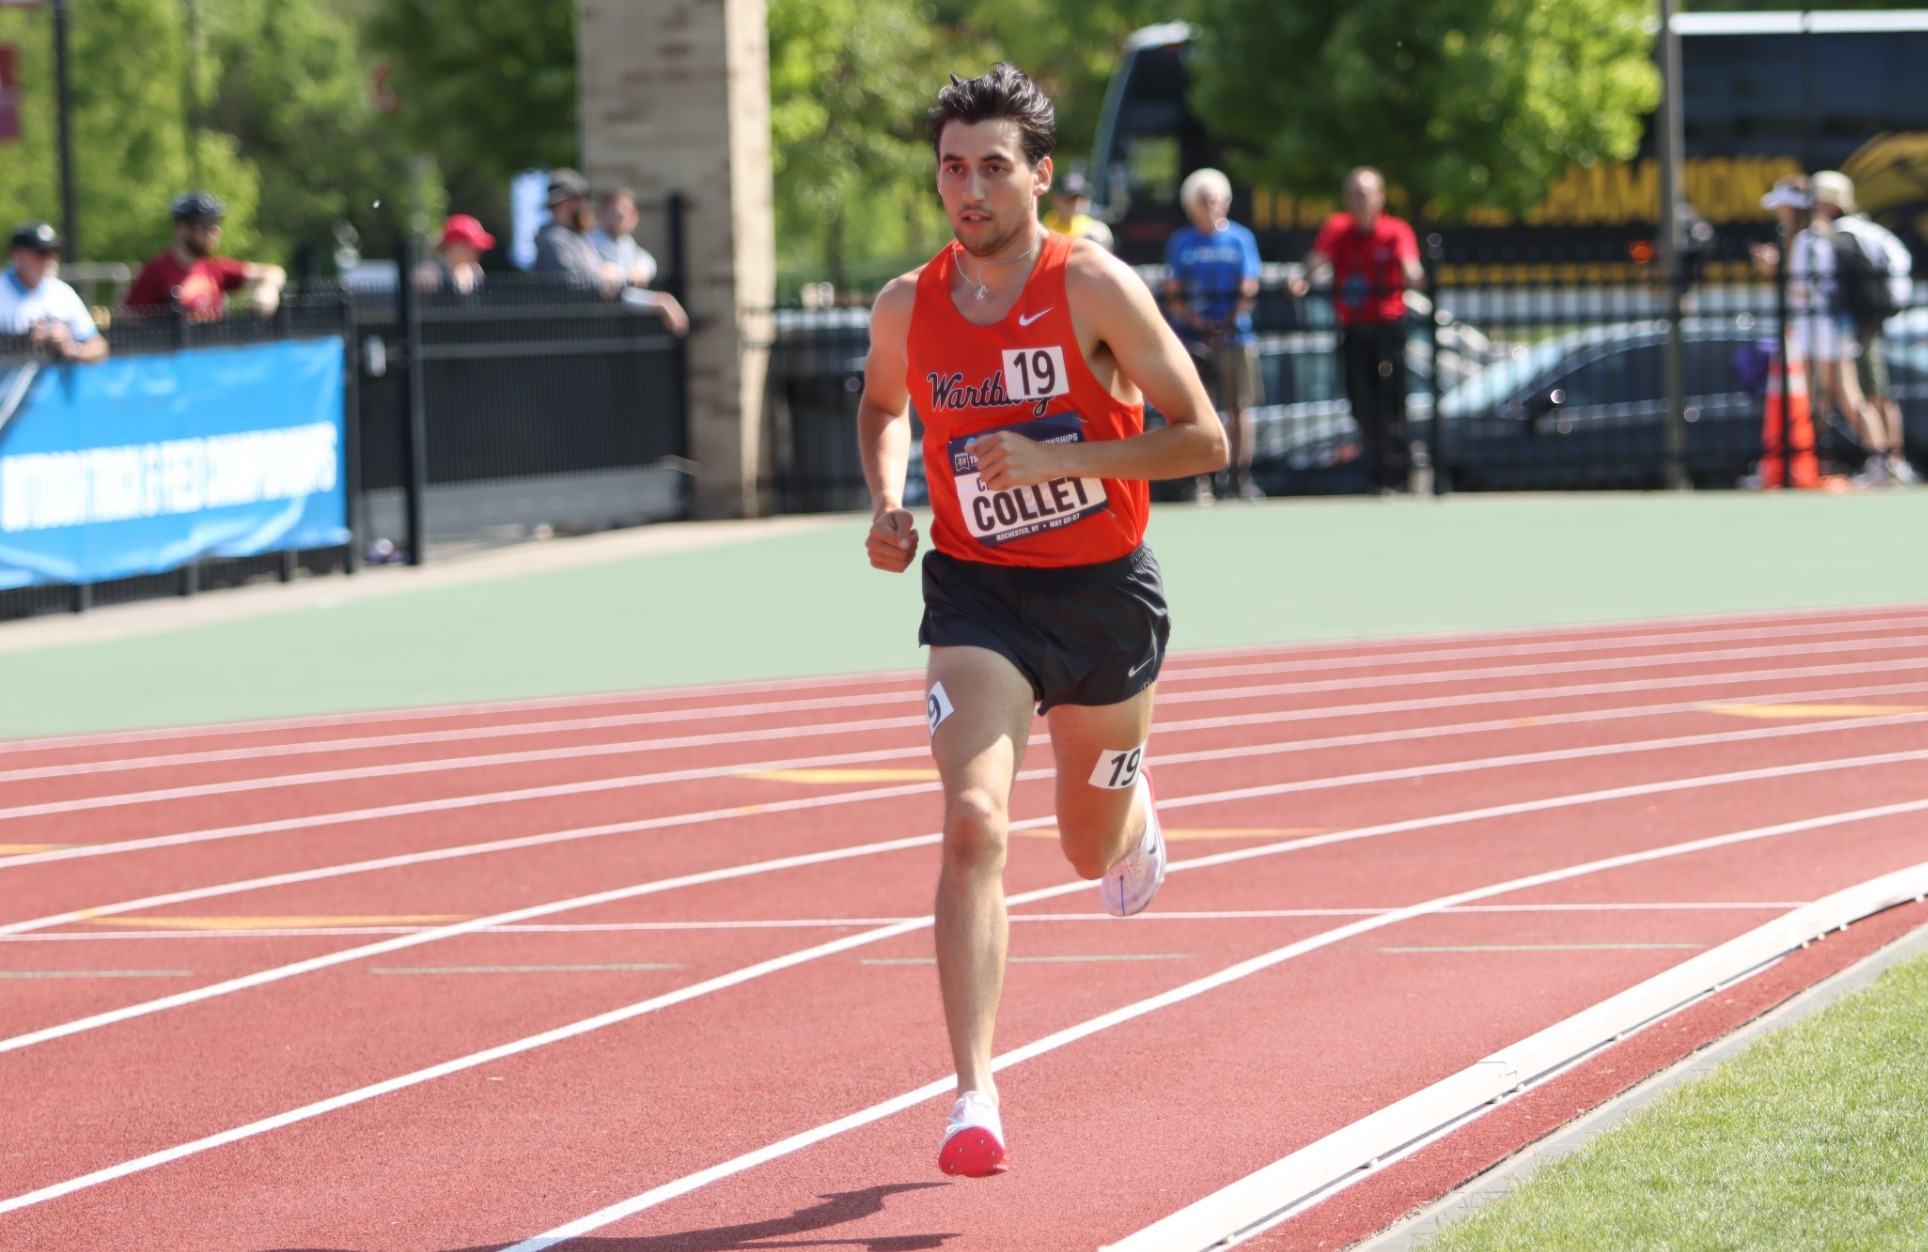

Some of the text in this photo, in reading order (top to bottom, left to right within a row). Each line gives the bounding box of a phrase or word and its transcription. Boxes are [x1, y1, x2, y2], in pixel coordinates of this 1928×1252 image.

[926, 370, 1057, 418] Wartbg
[1013, 350, 1056, 396] 19
[972, 477, 1089, 532] COLLET
[1031, 524, 1040, 533] NY
[1049, 518, 1062, 528] MAY
[1108, 747, 1141, 787] 19
